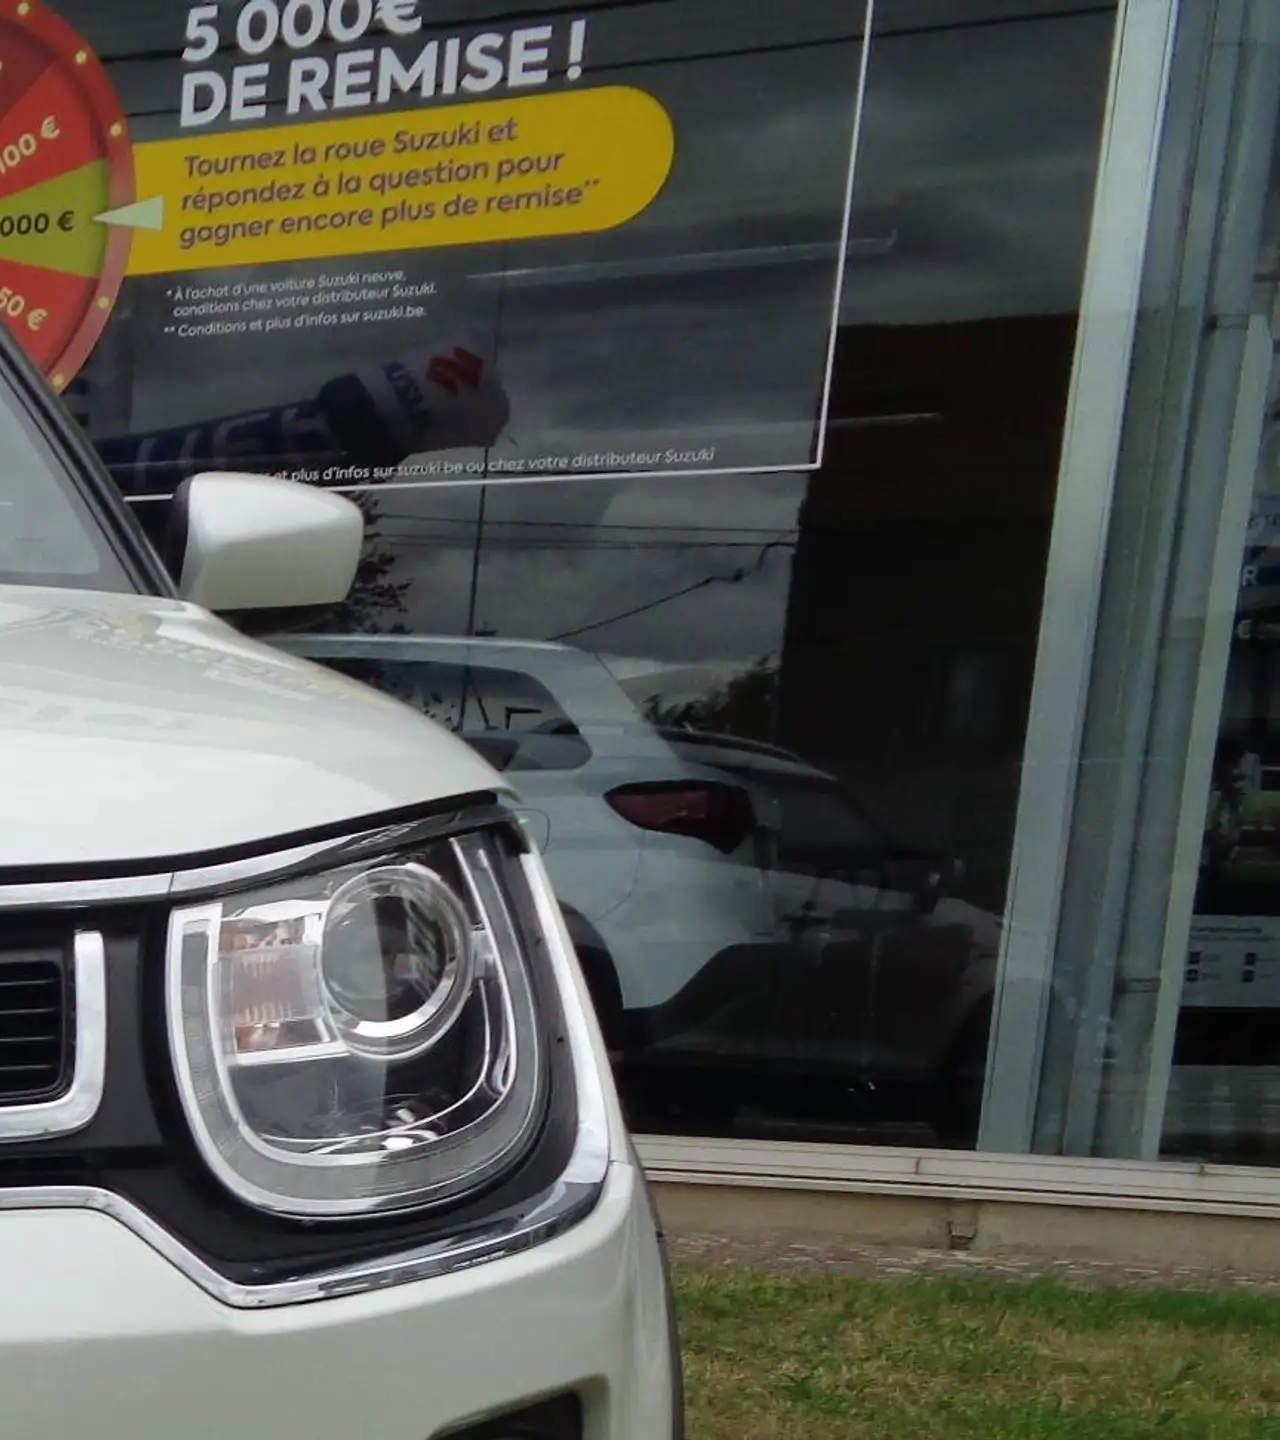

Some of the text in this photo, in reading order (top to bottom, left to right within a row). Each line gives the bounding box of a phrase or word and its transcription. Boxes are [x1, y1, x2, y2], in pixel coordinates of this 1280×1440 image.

[182, 5, 219, 62] 5
[180, 62, 269, 128] DE
[286, 24, 552, 115] REMISE
[40, 115, 60, 140] €
[185, 117, 518, 178] Tournez la roue Suzuki et
[181, 153, 565, 213] répondez à la question pour
[57, 210, 75, 232] €
[180, 219, 274, 250] gagner
[280, 208, 374, 234] encore
[381, 199, 435, 230] plus
[443, 193, 479, 217] de
[270, 277, 315, 292] voiture
[318, 273, 359, 288] Suzuki
[173, 302, 240, 318] conditions
[242, 298, 273, 312] chez
[275, 294, 310, 308] votre
[312, 286, 390, 306] distributeur
[27, 308, 48, 331] €
[178, 319, 246, 337] Conditions
[249, 317, 262, 332] et
[265, 315, 291, 333] plus
[339, 311, 360, 325] sur
[322, 464, 370, 481] d'infos
[373, 465, 395, 478] sur
[488, 457, 524, 472] chez
[528, 455, 568, 469] votre
[572, 450, 661, 469] distributeur
[664, 446, 716, 464] Suzuki
